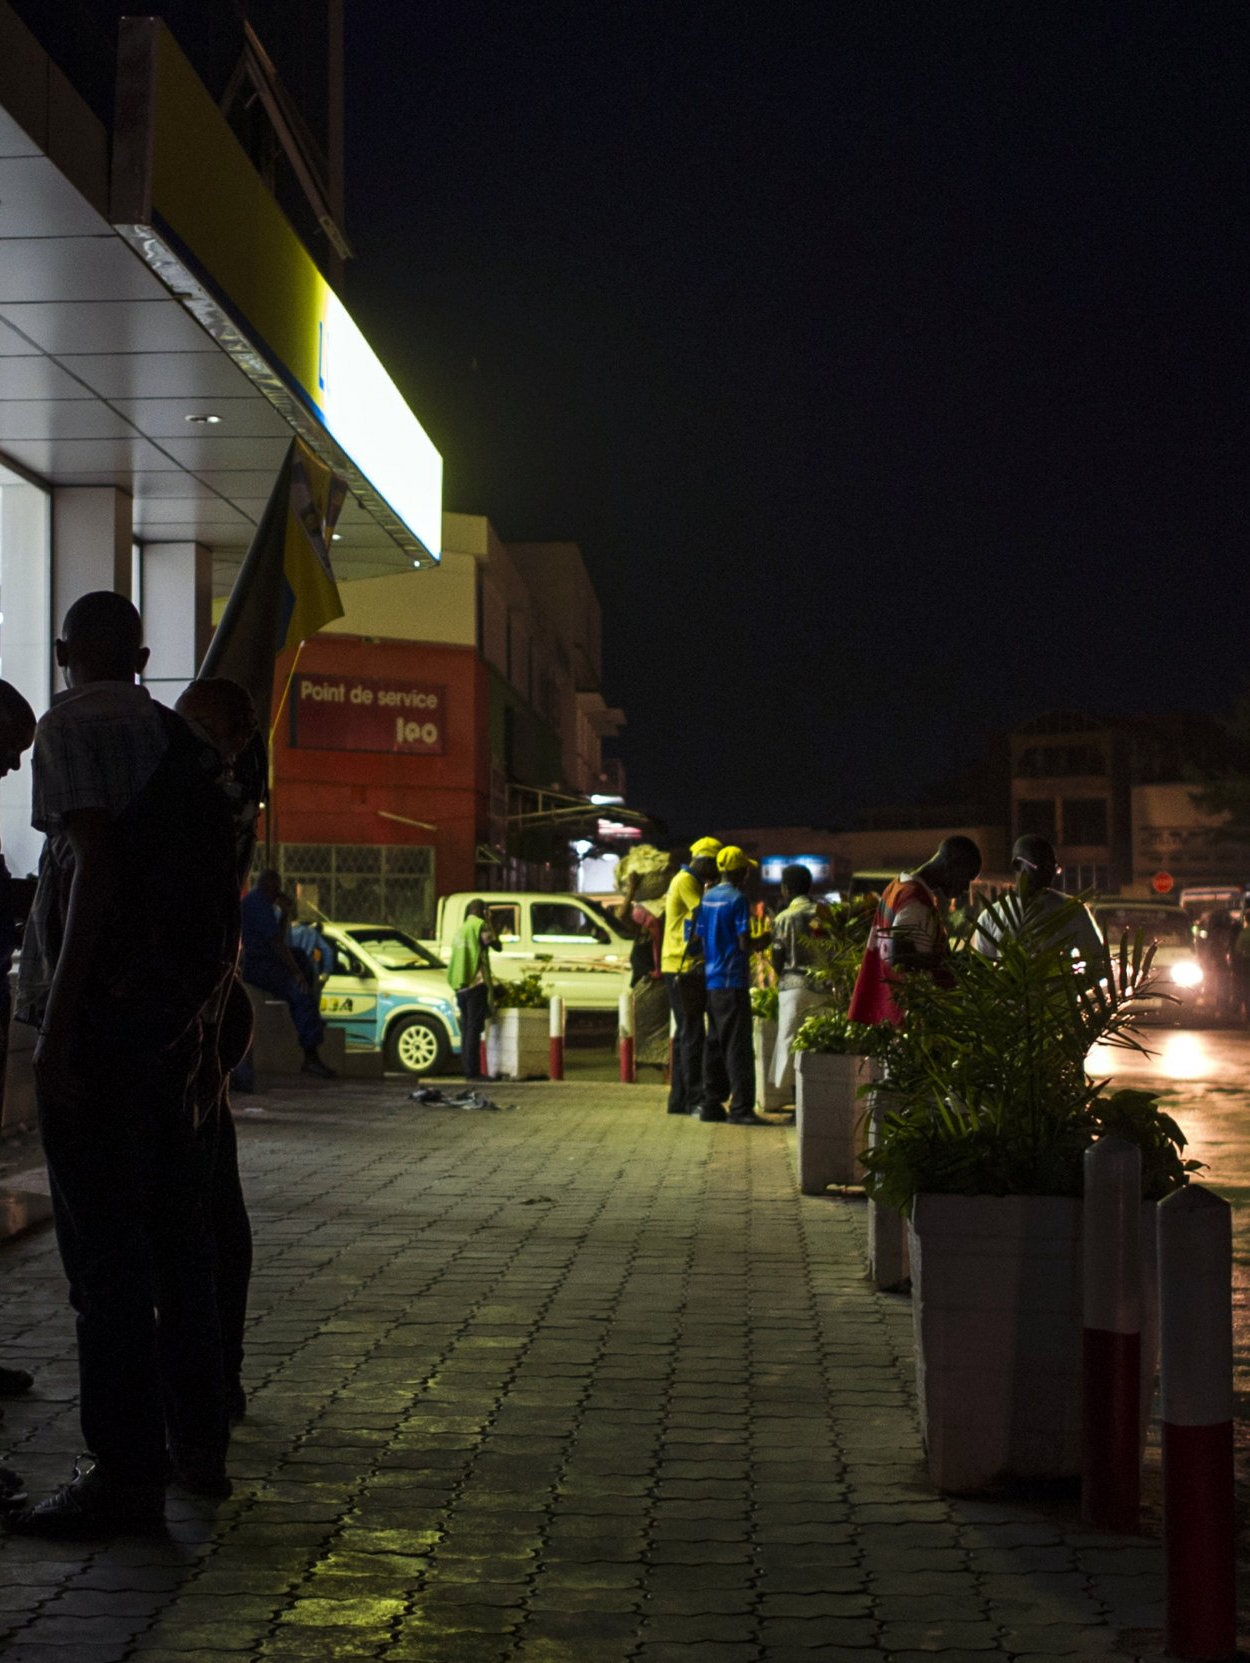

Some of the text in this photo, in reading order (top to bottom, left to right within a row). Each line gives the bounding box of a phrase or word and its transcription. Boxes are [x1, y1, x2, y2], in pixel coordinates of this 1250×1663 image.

[300, 680, 438, 709] Point de service
